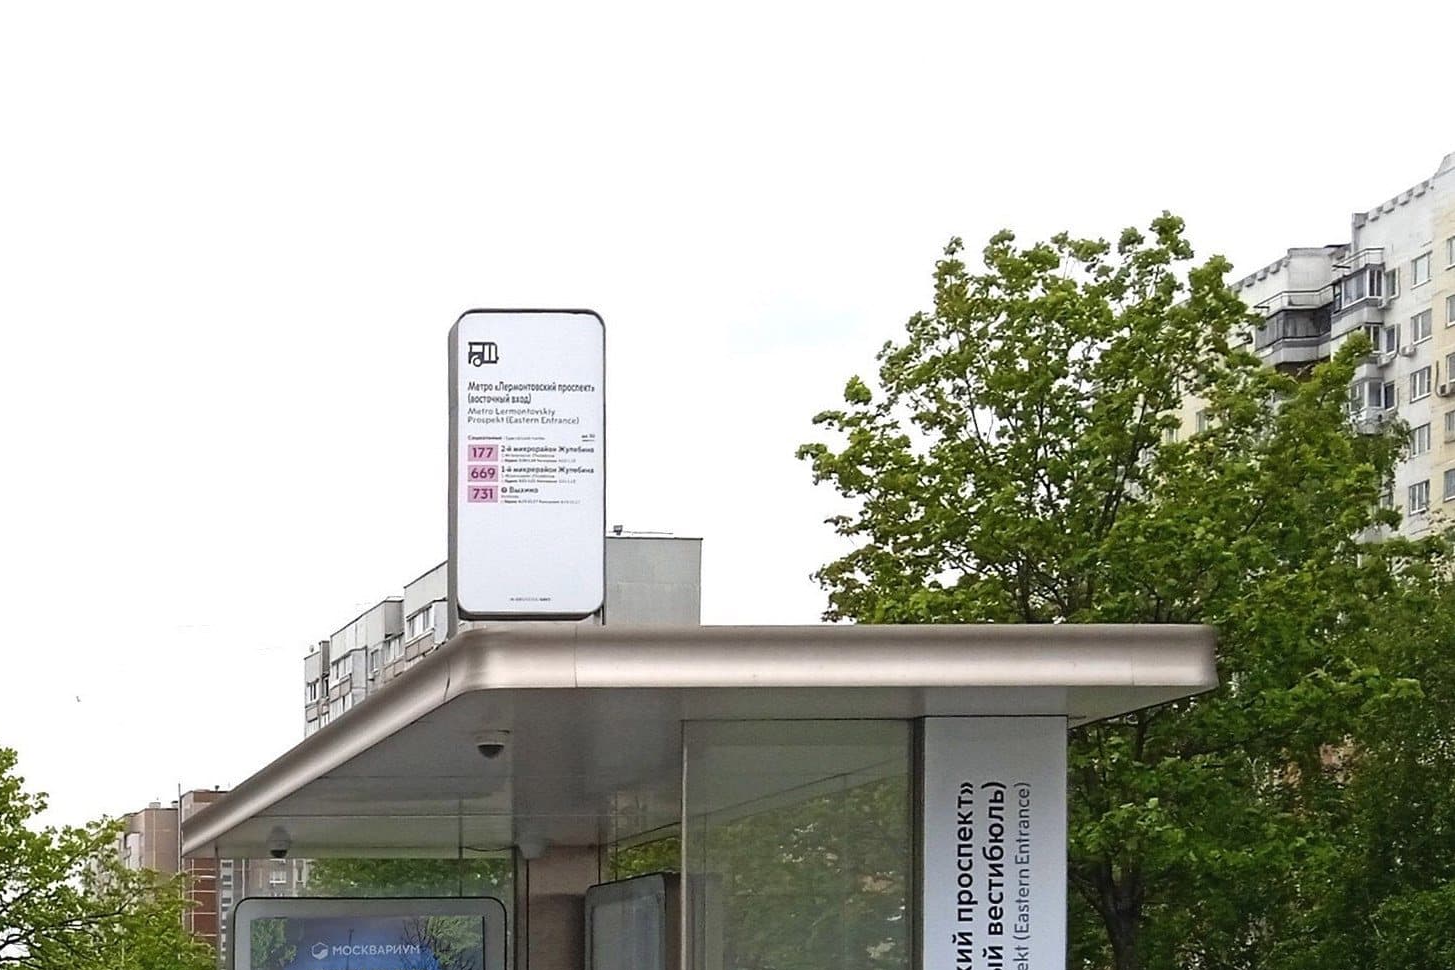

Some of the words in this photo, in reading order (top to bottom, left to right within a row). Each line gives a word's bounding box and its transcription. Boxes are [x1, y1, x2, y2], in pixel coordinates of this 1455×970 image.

[467, 381, 493, 392] Метро
[467, 393, 510, 404] (восточный
[511, 393, 531, 404] вход)
[467, 407, 493, 415] Metro
[495, 407, 555, 416] Lermontovskiy
[467, 416, 504, 424] Prospekt
[506, 416, 539, 424] (Eastern
[541, 416, 580, 424] Entrance)
[472, 447, 494, 458] 177
[470, 467, 496, 479] 669
[472, 488, 494, 499] 731
[1013, 782, 1031, 865] Entrance)
[957, 782, 978, 922] проспект»
[981, 781, 1007, 935] вестибюль)
[1013, 868, 1031, 941] (Eastern
[332, 944, 421, 956] МОСКВАРИУМ
